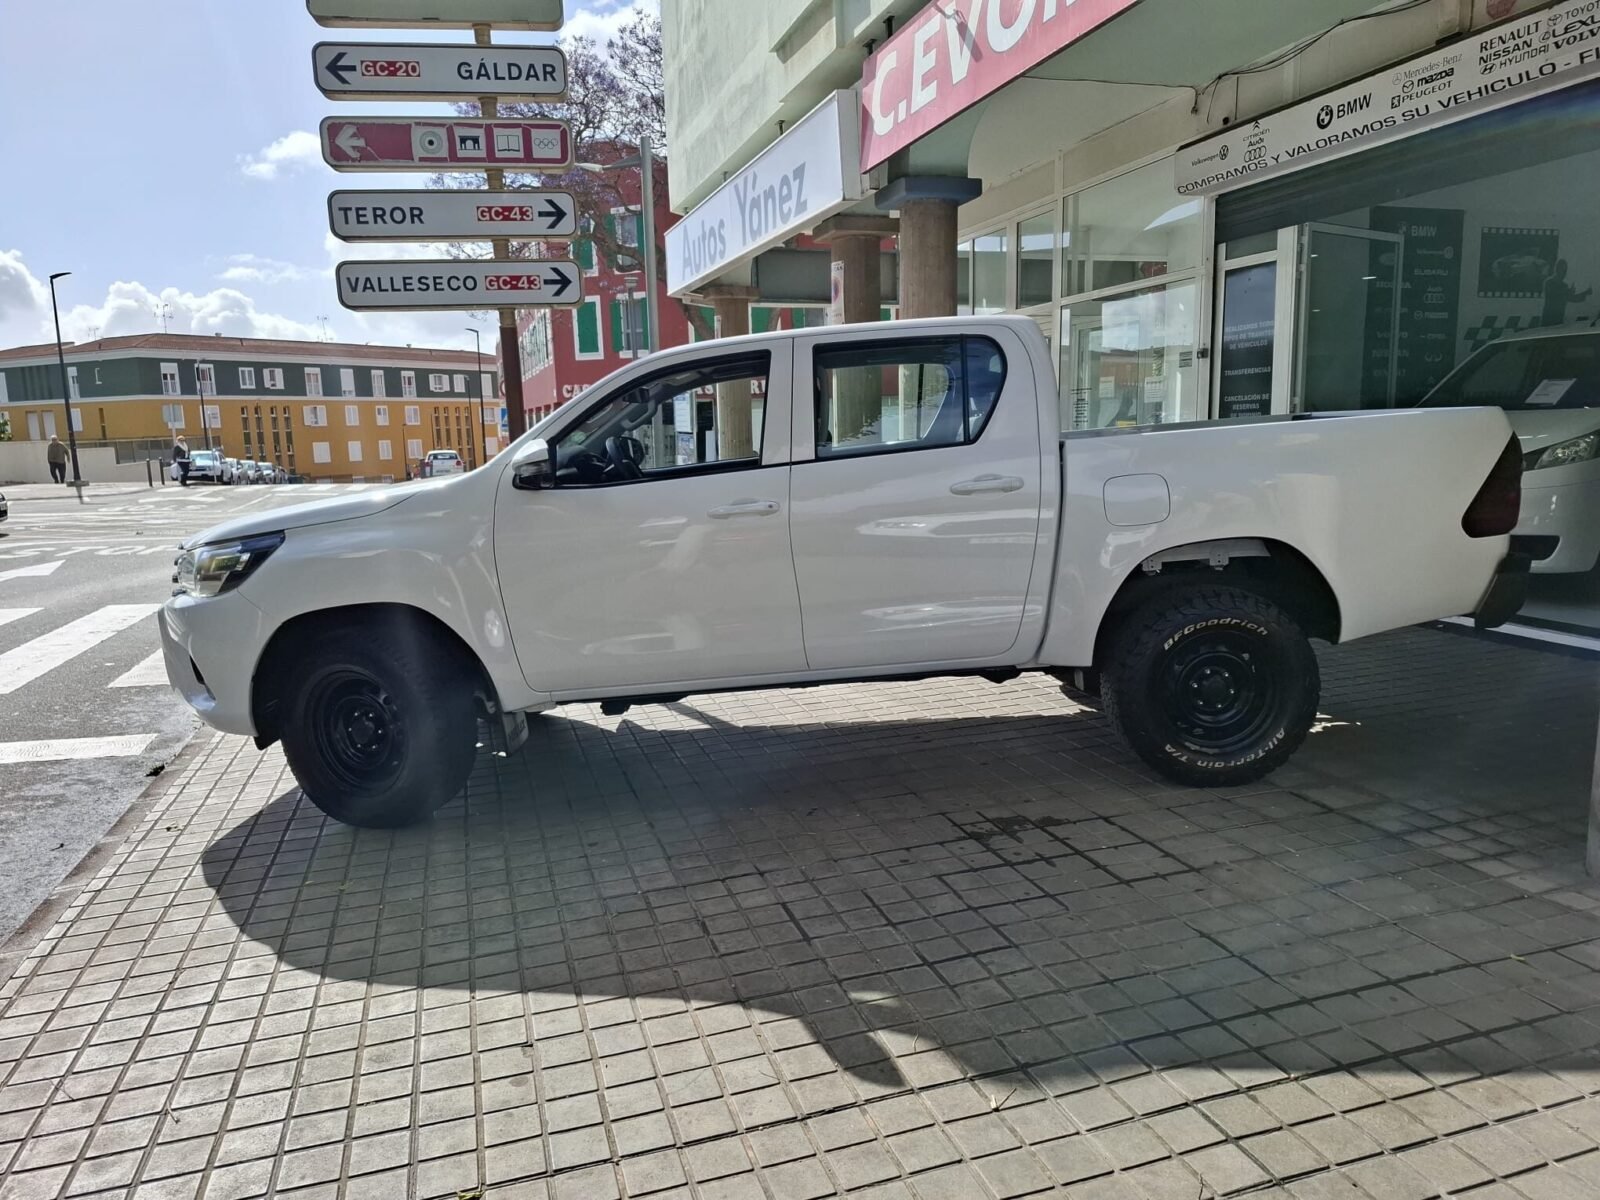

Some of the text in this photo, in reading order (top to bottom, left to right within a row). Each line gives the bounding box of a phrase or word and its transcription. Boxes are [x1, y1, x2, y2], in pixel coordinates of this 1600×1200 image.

[1480, 21, 1541, 53] RENAULT
[1479, 39, 1533, 66] NISSAN
[1500, 44, 1549, 69] HYUNDAI
[361, 58, 557, 82] GC-20 GÁLDAR
[870, 0, 1082, 137] C.EVO
[1403, 53, 1462, 81] Mercedes-Benz
[1402, 80, 1453, 103] PEUGEOT
[1336, 92, 1372, 119] BMW
[1177, 159, 1268, 194] COMPRAMOS
[1271, 153, 1281, 164] Y
[1285, 116, 1397, 159] VALORAMOS
[1402, 104, 1430, 122] SU
[1438, 62, 1557, 110] VEHICULO
[1247, 137, 1265, 148] Audi
[338, 206, 533, 225] TEROR GC-43
[681, 160, 808, 282] Autos Yánez
[1411, 225, 1437, 237] BMW
[346, 275, 541, 293] VALLESECO GC-43
[1163, 617, 1269, 651] BFGoodrich
